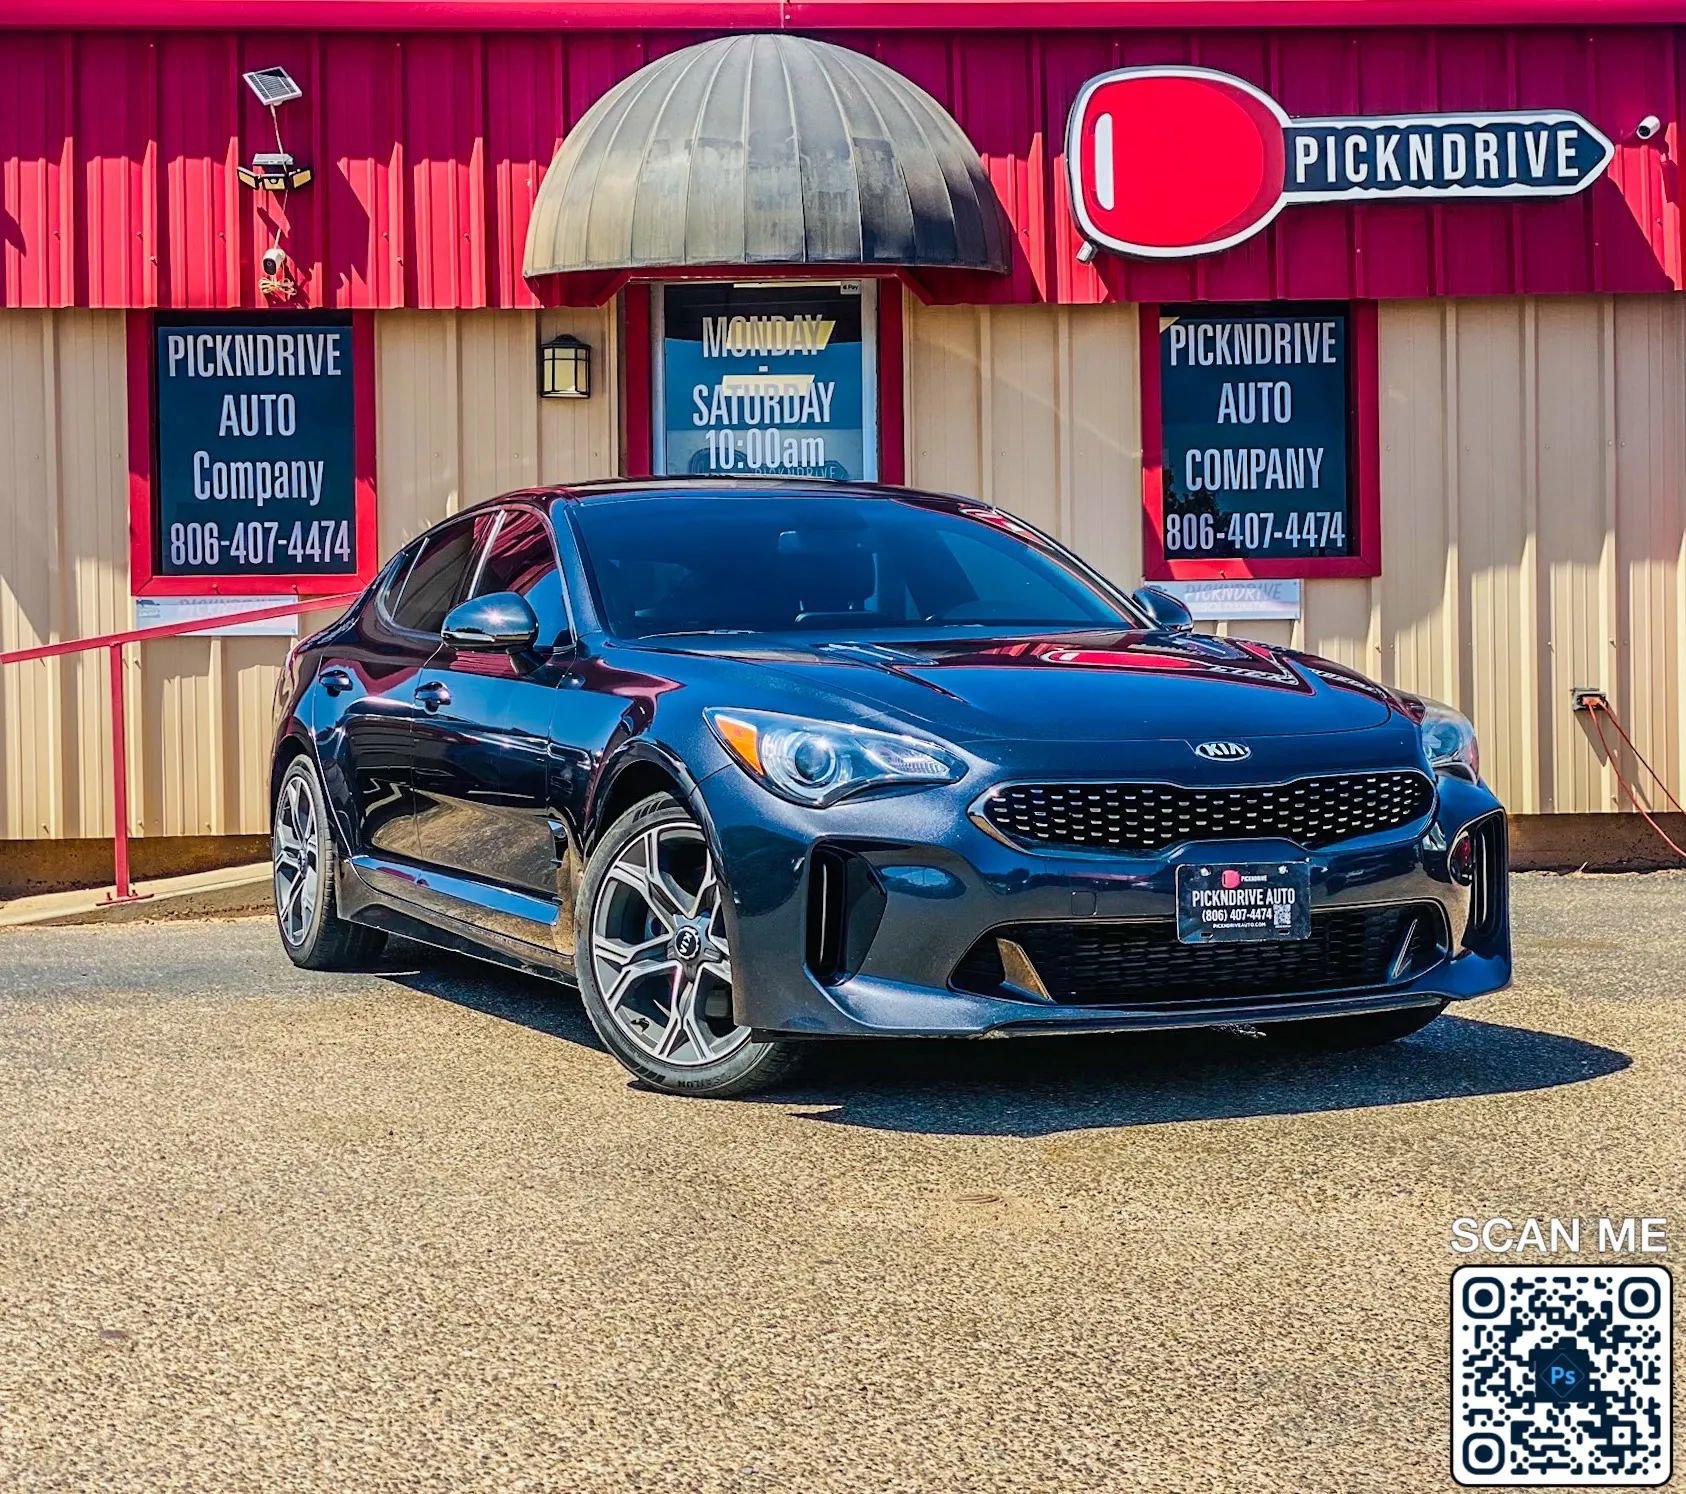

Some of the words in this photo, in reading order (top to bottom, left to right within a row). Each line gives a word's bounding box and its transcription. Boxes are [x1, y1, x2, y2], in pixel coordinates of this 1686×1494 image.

[1296, 129, 1579, 184] PICKNDRIVE
[168, 334, 342, 377] PICKNDRIVE
[702, 314, 823, 359] MONDAY
[1170, 322, 1337, 367] PICKNDRIVE
[218, 393, 297, 437] AUTO
[692, 382, 836, 427] SATURDAY
[1217, 381, 1293, 424] AUTO
[705, 428, 825, 470] 10:00am
[1185, 448, 1324, 491] COMPANY
[193, 450, 324, 507] Company
[170, 520, 351, 566] 806-407-4474
[1166, 511, 1346, 551] 806-407-4474
[1184, 583, 1283, 600] PICKNDRIVE
[1201, 743, 1246, 757] KIA
[1192, 889, 1264, 907] PICKNDRIVE
[1266, 888, 1296, 905] AUTO
[1202, 909, 1228, 922] (806)
[1230, 908, 1273, 921] 407-4474
